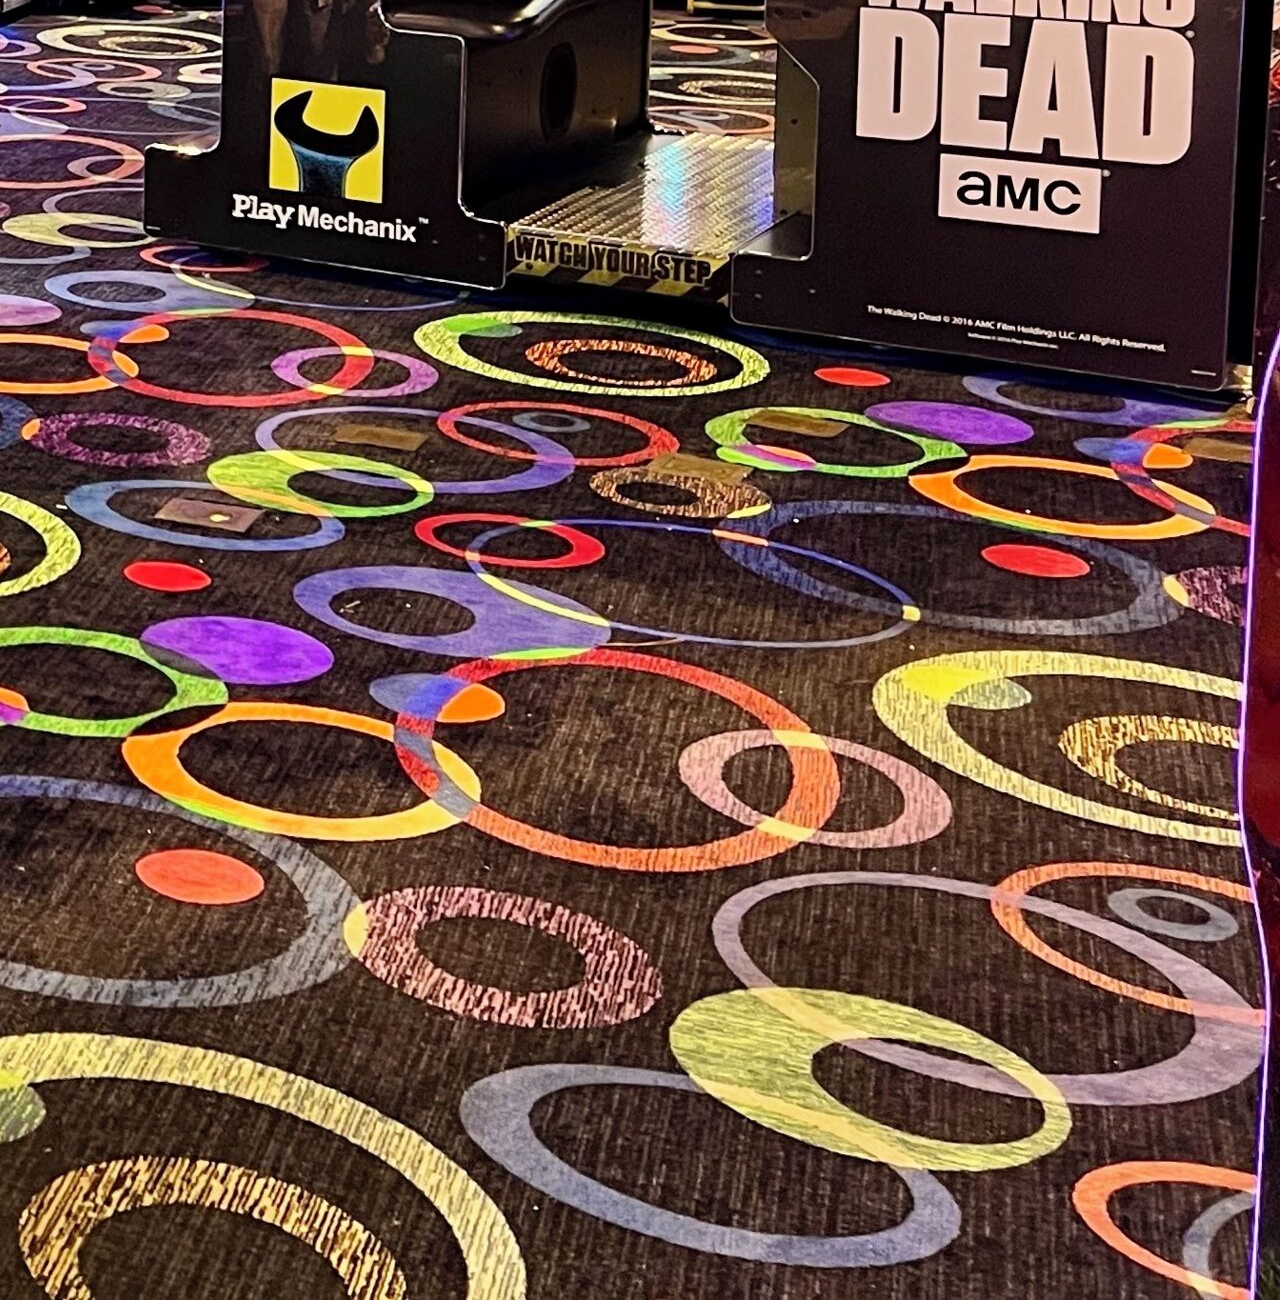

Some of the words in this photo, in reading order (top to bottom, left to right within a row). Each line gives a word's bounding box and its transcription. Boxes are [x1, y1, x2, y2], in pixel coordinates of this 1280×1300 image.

[856, 7, 1195, 165] DEAD
[232, 194, 295, 229] Play
[298, 204, 417, 243] Mechanix
[515, 234, 588, 270] WATCH
[591, 242, 652, 277] YOUR
[655, 252, 712, 285] STEP
[867, 305, 882, 315] The
[883, 307, 917, 321] Walking
[919, 311, 942, 322] Dead
[951, 315, 973, 326] 2016
[974, 319, 996, 329] AMC
[996, 322, 1016, 332] Film
[1078, 332, 1091, 342] All
[1091, 335, 1120, 347] Rights
